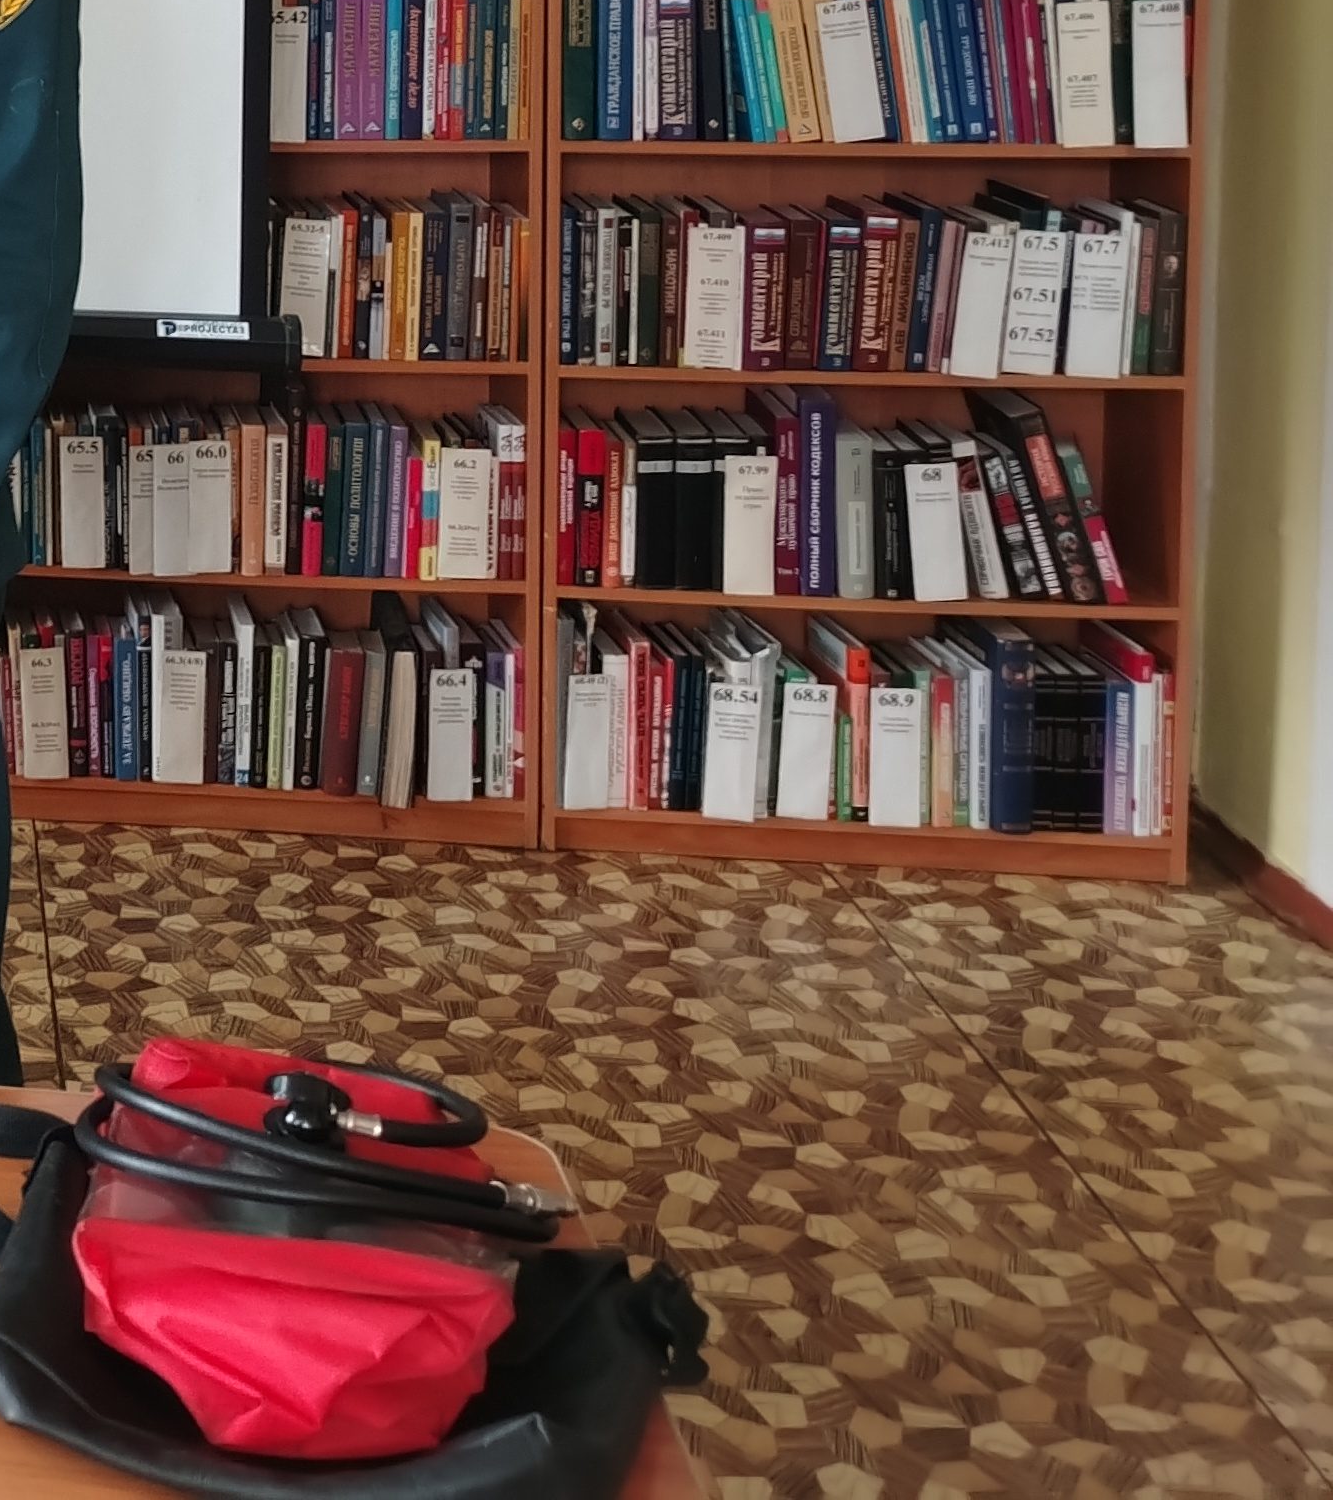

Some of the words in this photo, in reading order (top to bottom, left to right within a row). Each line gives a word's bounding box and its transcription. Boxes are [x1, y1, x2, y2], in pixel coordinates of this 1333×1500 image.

[822, 2, 860, 14] 67.405
[343, 3, 357, 78] МАРКЕТИНГ
[368, 3, 381, 78] МАРКЕТИНГ
[961, 35, 974, 77] ТРУДОВОЕ
[607, 32, 622, 114] ГРАЖДАНСКОЕ
[660, 19, 686, 125] Комментарий
[966, 78, 977, 106] ПРАВО
[602, 231, 613, 271] УГОЛОВНОЕ
[972, 236, 1009, 248] 67.412
[1023, 236, 1059, 251] 67.5
[1083, 240, 1120, 255] 67.7
[602, 274, 612, 296] ПРАВО
[664, 248, 677, 314] НАРКОТИКИ
[898, 231, 916, 324] МИЛЬЯНЕНКОВ
[602, 298, 612, 308] РФ
[750, 252, 781, 352] Комментарий
[825, 249, 844, 356] Комментарий
[860, 239, 884, 350] Комментарий
[1013, 286, 1057, 304] 67.51
[895, 329, 906, 354] ЛЕВ
[1008, 326, 1055, 343] 67.52
[67, 441, 98, 455] 65.5
[167, 451, 183, 465] 66
[195, 445, 226, 459] 66.0
[810, 412, 822, 476] КОДЕКСОВ
[351, 437, 364, 509] ПОЛИТОЛОГИИ
[391, 440, 403, 505] ПОЛИТОЛОГИЮ
[610, 450, 620, 489] АДВОКАТ
[738, 466, 770, 475] 67.99
[921, 468, 941, 481] 68
[608, 491, 619, 541] ДОМАШНИЙ
[809, 478, 821, 534] СБОРНИК
[348, 514, 361, 556] ОСНОВЫ
[389, 512, 400, 559] ВВЕДЕНИЕ
[608, 542, 617, 562] ВАШ
[808, 537, 819, 588] ПОЛНЫЙ
[1024, 512, 1063, 595] КАЛАШНИКОВА
[31, 658, 52, 668] 66.3
[436, 674, 466, 687] 66.4
[713, 688, 758, 704] 68.54
[793, 688, 829, 703] 68.8
[878, 693, 914, 708] 68.9
[121, 705, 132, 751] ДЕРЖАВУ
[122, 752, 132, 765] ЗА
